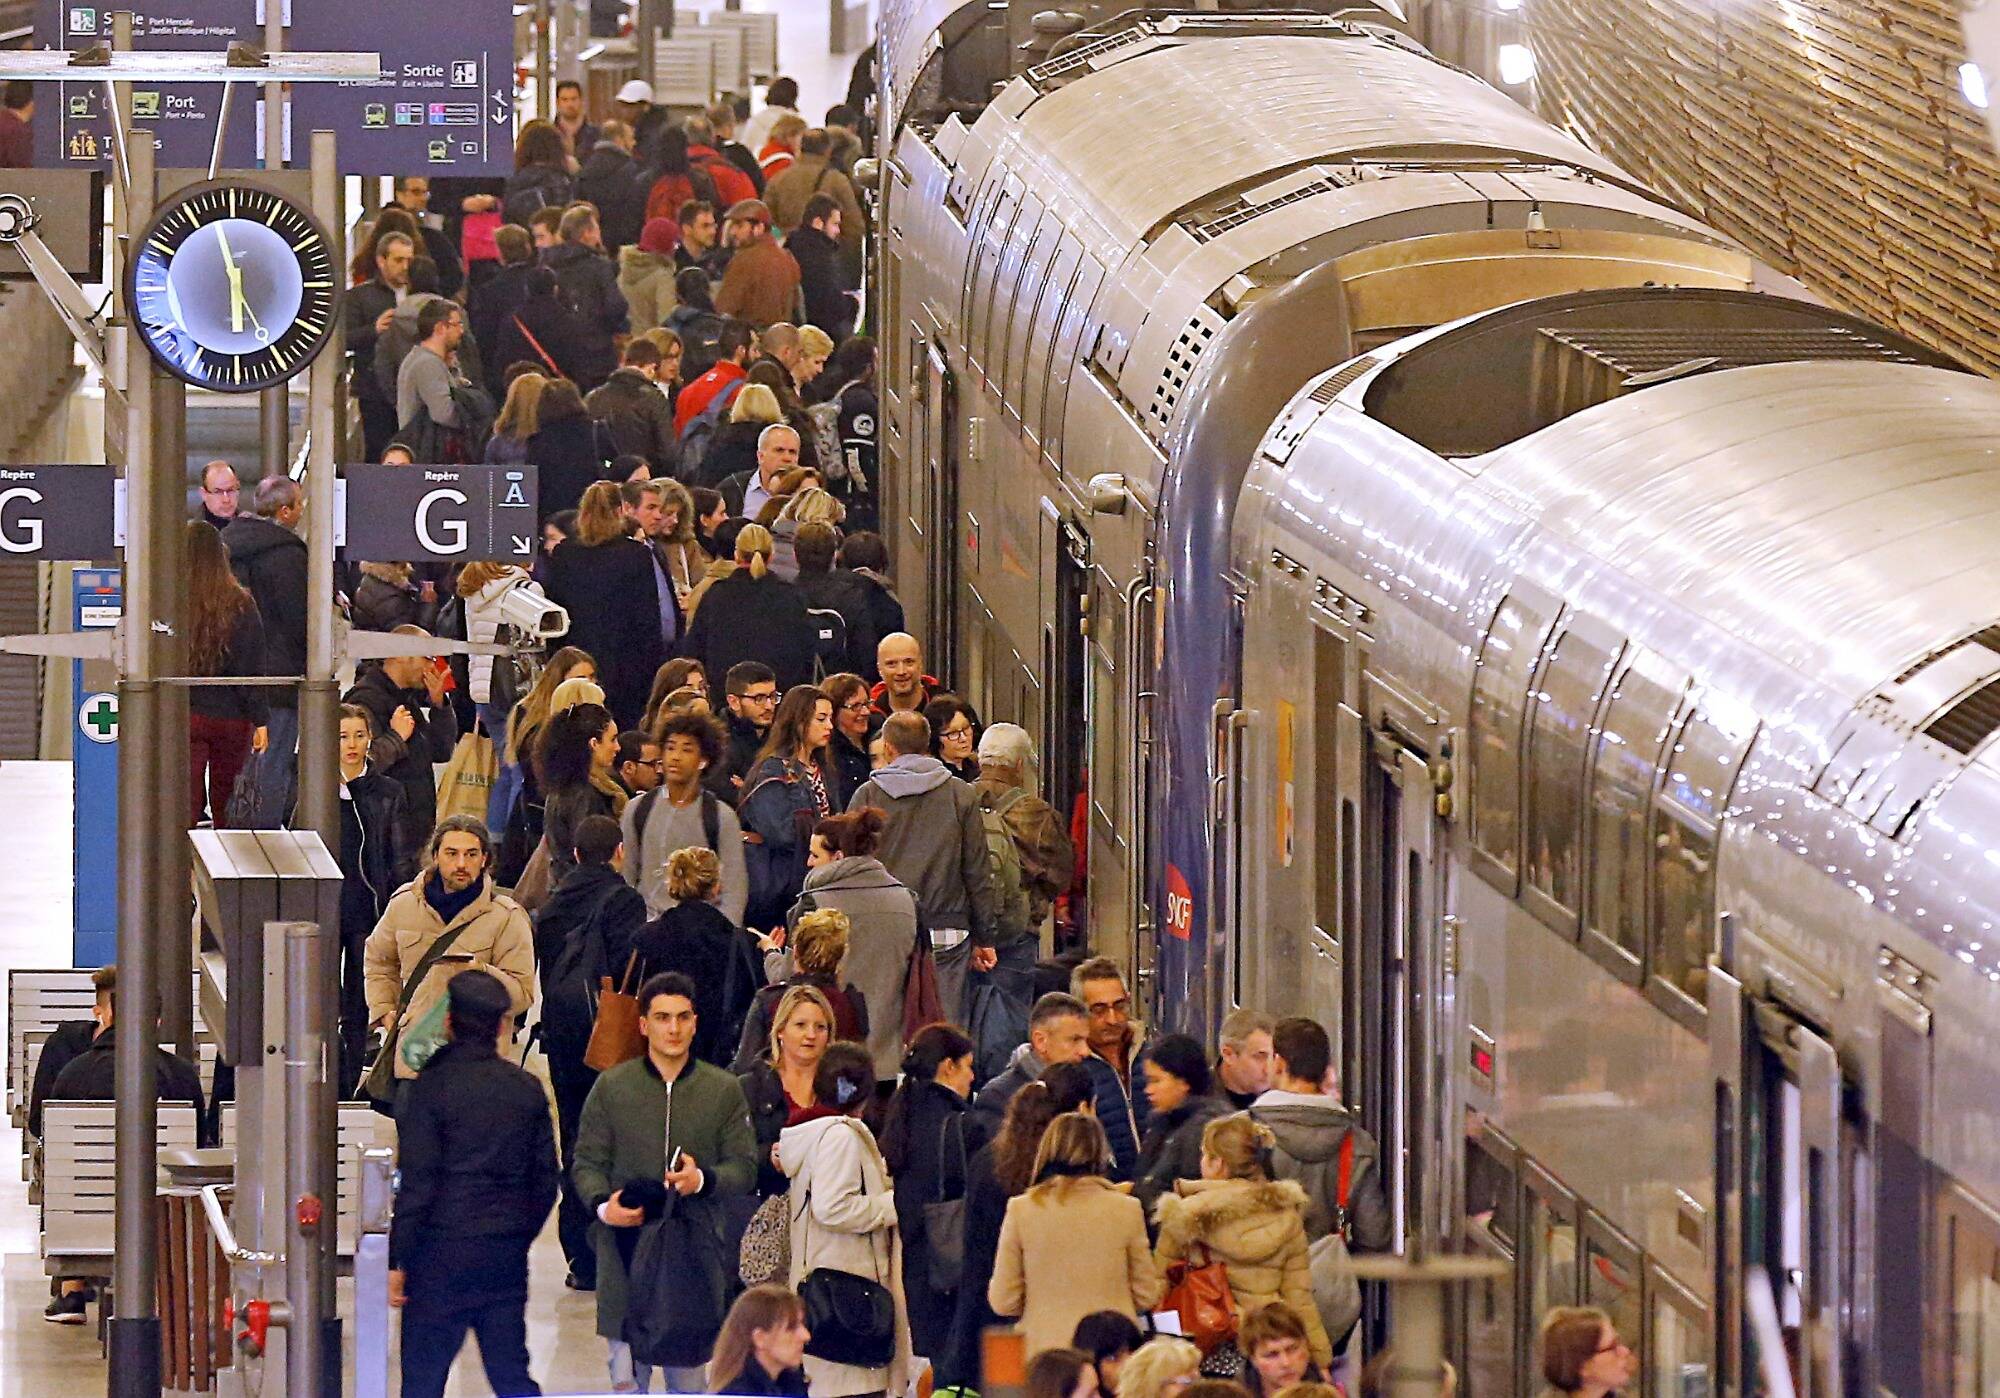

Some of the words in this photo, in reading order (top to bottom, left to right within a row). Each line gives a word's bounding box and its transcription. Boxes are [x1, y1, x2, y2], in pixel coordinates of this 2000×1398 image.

[103, 11, 144, 25] Sie
[149, 17, 165, 25] Port
[403, 64, 444, 77] Sortie
[166, 95, 195, 108] Port
[1, 469, 36, 481] Repère
[424, 470, 460, 482] Repère
[505, 482, 524, 503] A
[0, 487, 44, 553] G
[414, 488, 468, 554] G
[1166, 892, 1191, 929] SNCF
